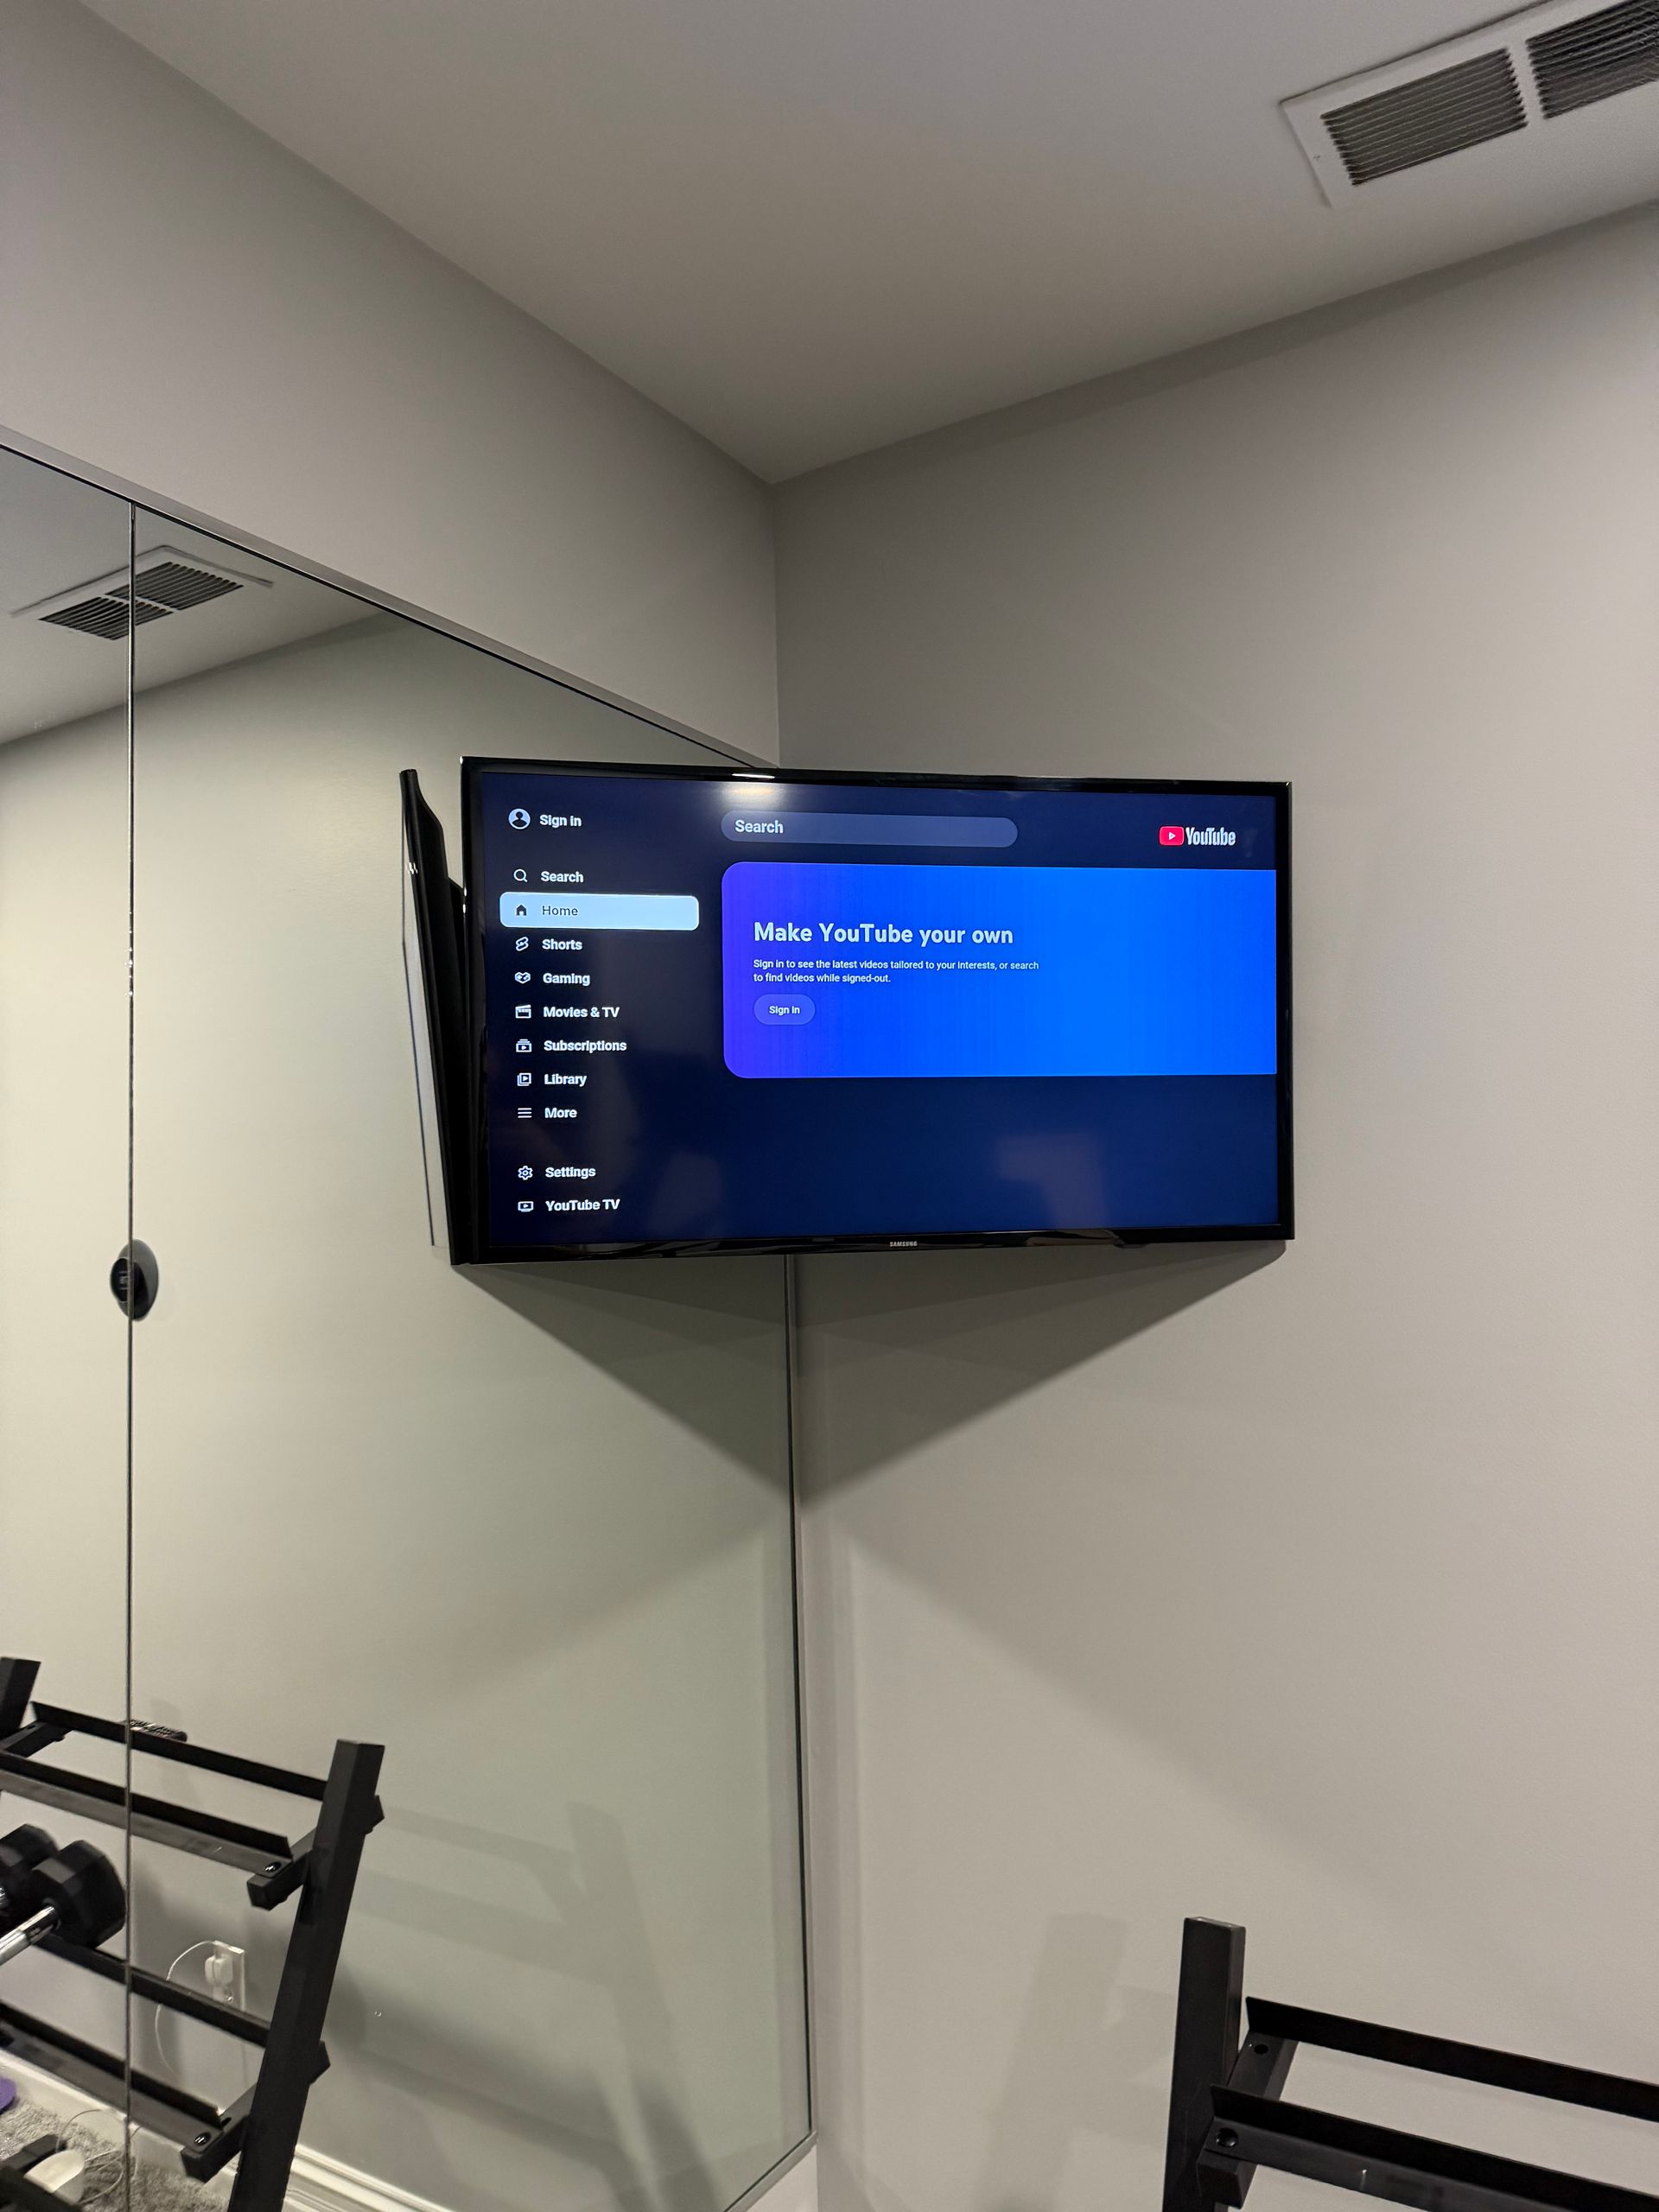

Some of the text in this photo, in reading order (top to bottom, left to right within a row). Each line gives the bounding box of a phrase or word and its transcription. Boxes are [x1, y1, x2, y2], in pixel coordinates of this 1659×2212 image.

[539, 814, 567, 829] Sign
[734, 819, 784, 834] Search
[1185, 827, 1236, 846] YouTube
[540, 870, 584, 883] Search
[542, 905, 579, 916] Home
[753, 921, 1014, 948] Make YouTube your own
[542, 938, 583, 950] Shorts
[753, 959, 774, 970] Sign
[775, 959, 785, 969] in
[785, 960, 796, 969] to
[816, 960, 831, 969] the
[832, 960, 858, 969] latest
[859, 960, 888, 969] videos
[890, 961, 924, 969] tailored
[937, 962, 956, 971] your
[957, 961, 998, 970] interests,
[1010, 962, 1039, 970] search
[543, 972, 591, 987] Gaming
[753, 973, 892, 984] to find videos while signed-out.
[543, 1006, 620, 1018] Movies & TV
[768, 1005, 790, 1016] Sign
[543, 1039, 627, 1054] Subscriptions
[543, 1073, 588, 1087] Library
[544, 1107, 578, 1119] More
[544, 1166, 596, 1180] Settings
[544, 1198, 621, 1211] YouTube TV
